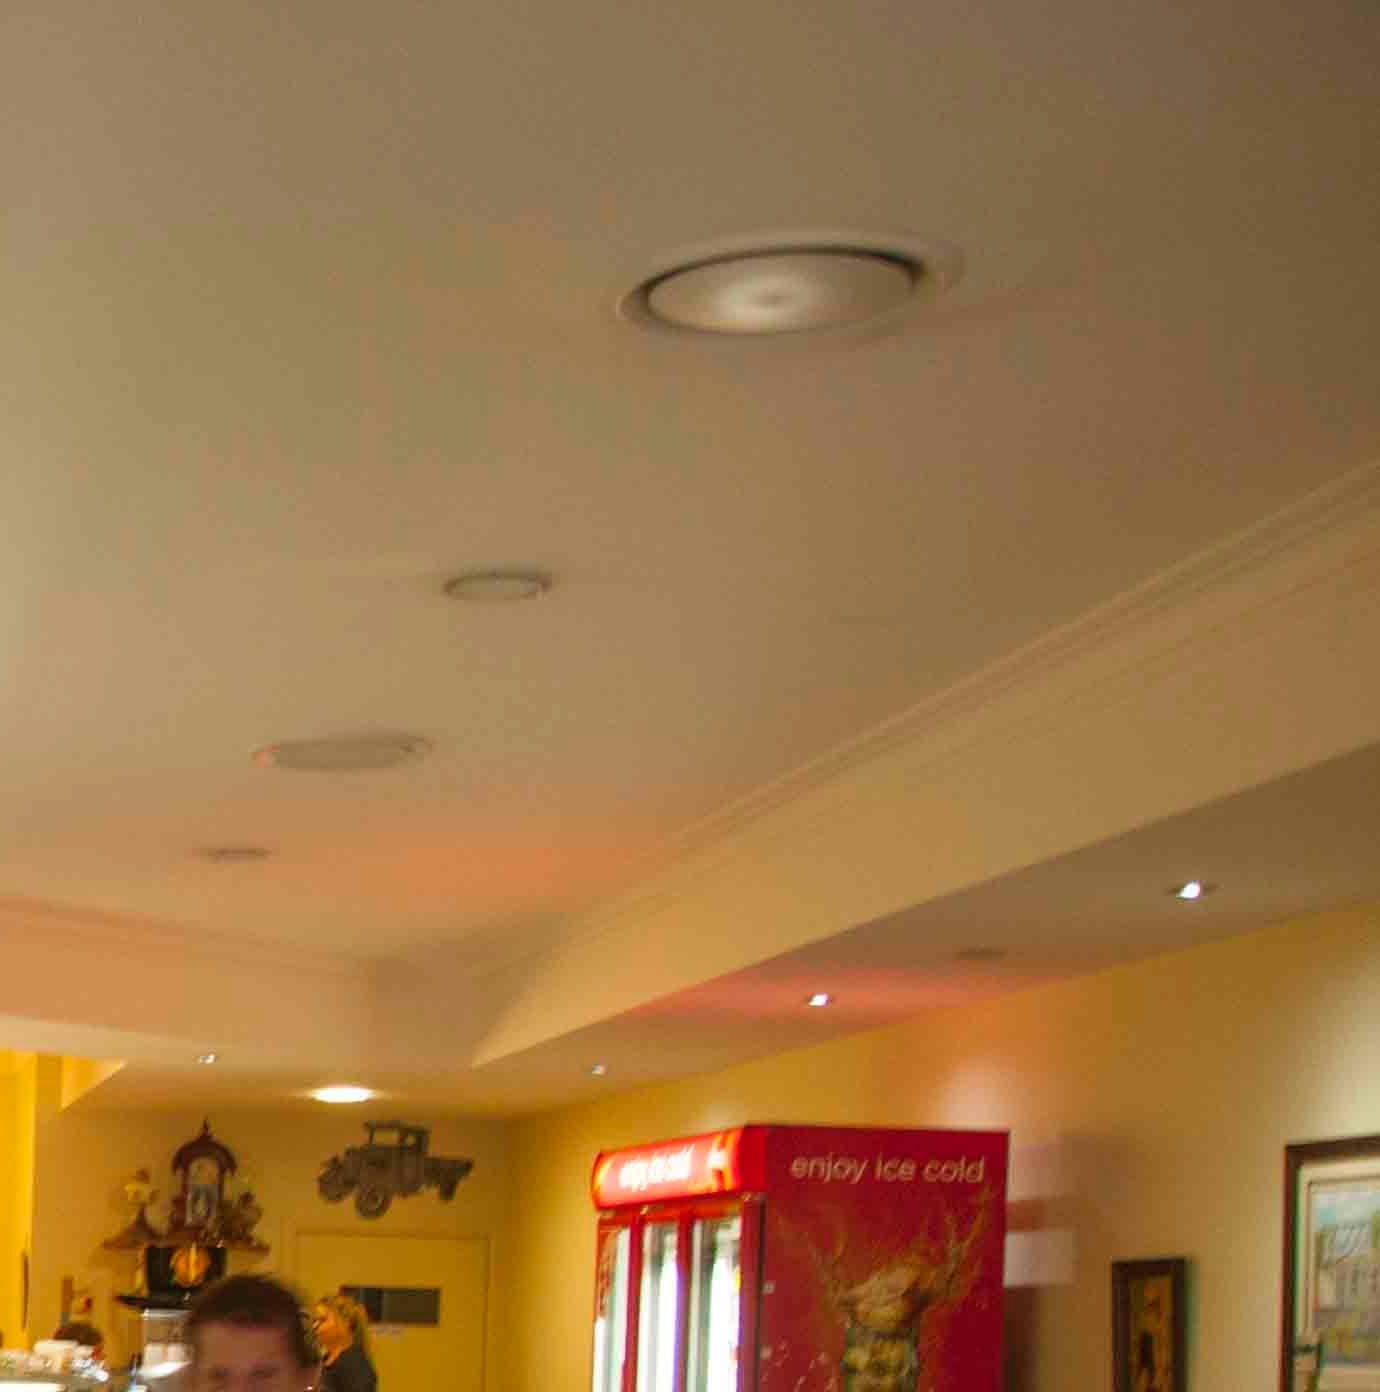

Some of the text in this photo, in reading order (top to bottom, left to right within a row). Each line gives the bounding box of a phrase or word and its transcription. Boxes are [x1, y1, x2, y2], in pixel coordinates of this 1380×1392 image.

[790, 1151, 985, 1185] enjoy ice cold
